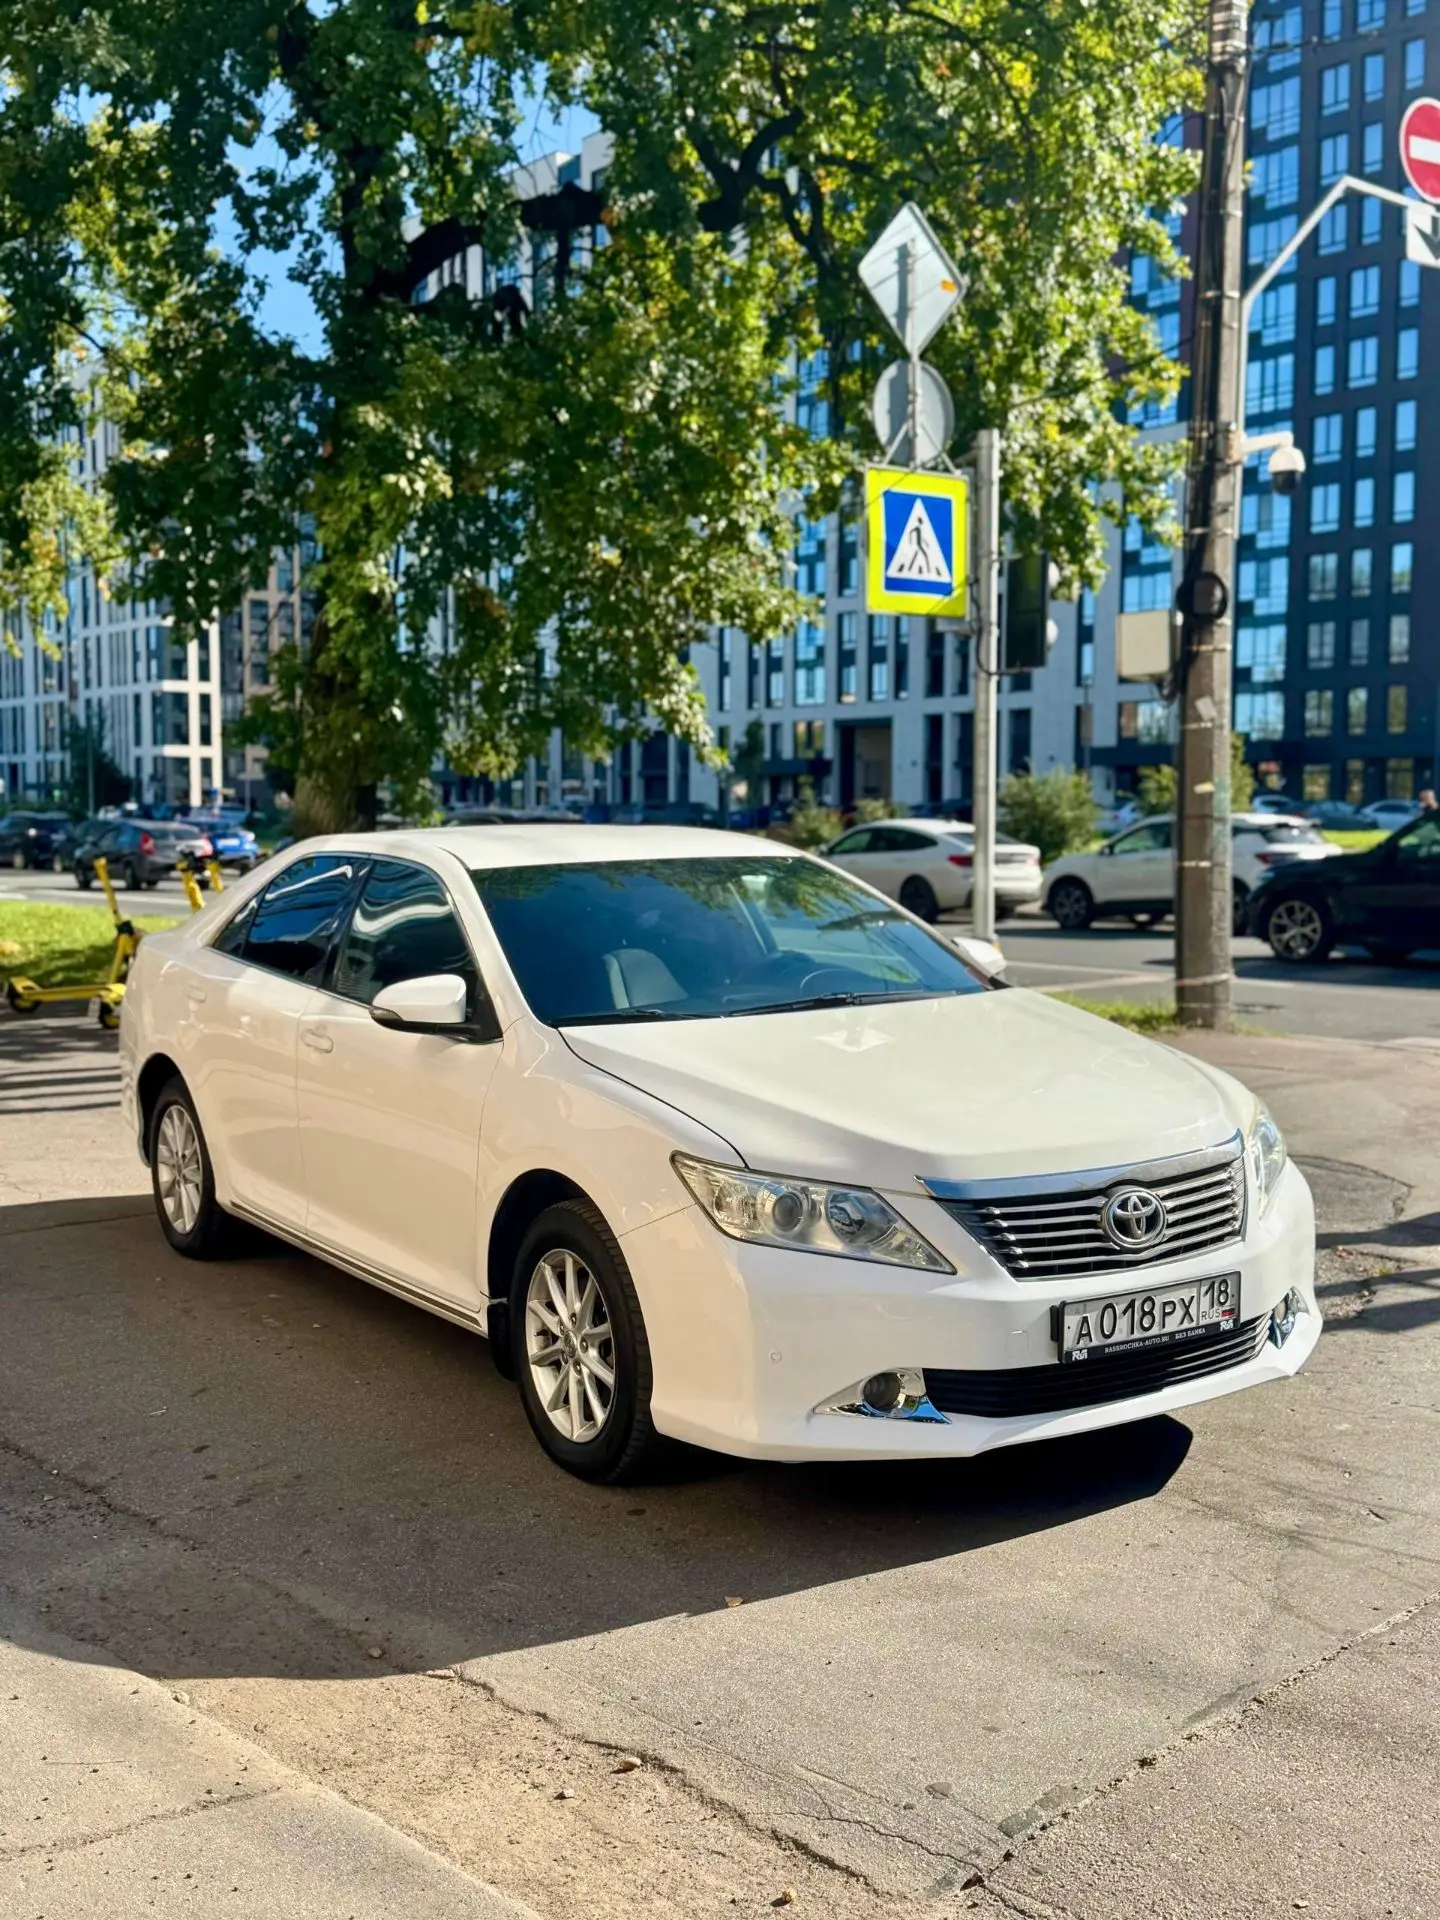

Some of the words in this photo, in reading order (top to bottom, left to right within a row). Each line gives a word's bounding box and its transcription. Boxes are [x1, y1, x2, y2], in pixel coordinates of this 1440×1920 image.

[1203, 1278, 1229, 1309] 18
[1201, 1308, 1220, 1320] RUS
[1175, 1331, 1187, 1340] БЕЗ
